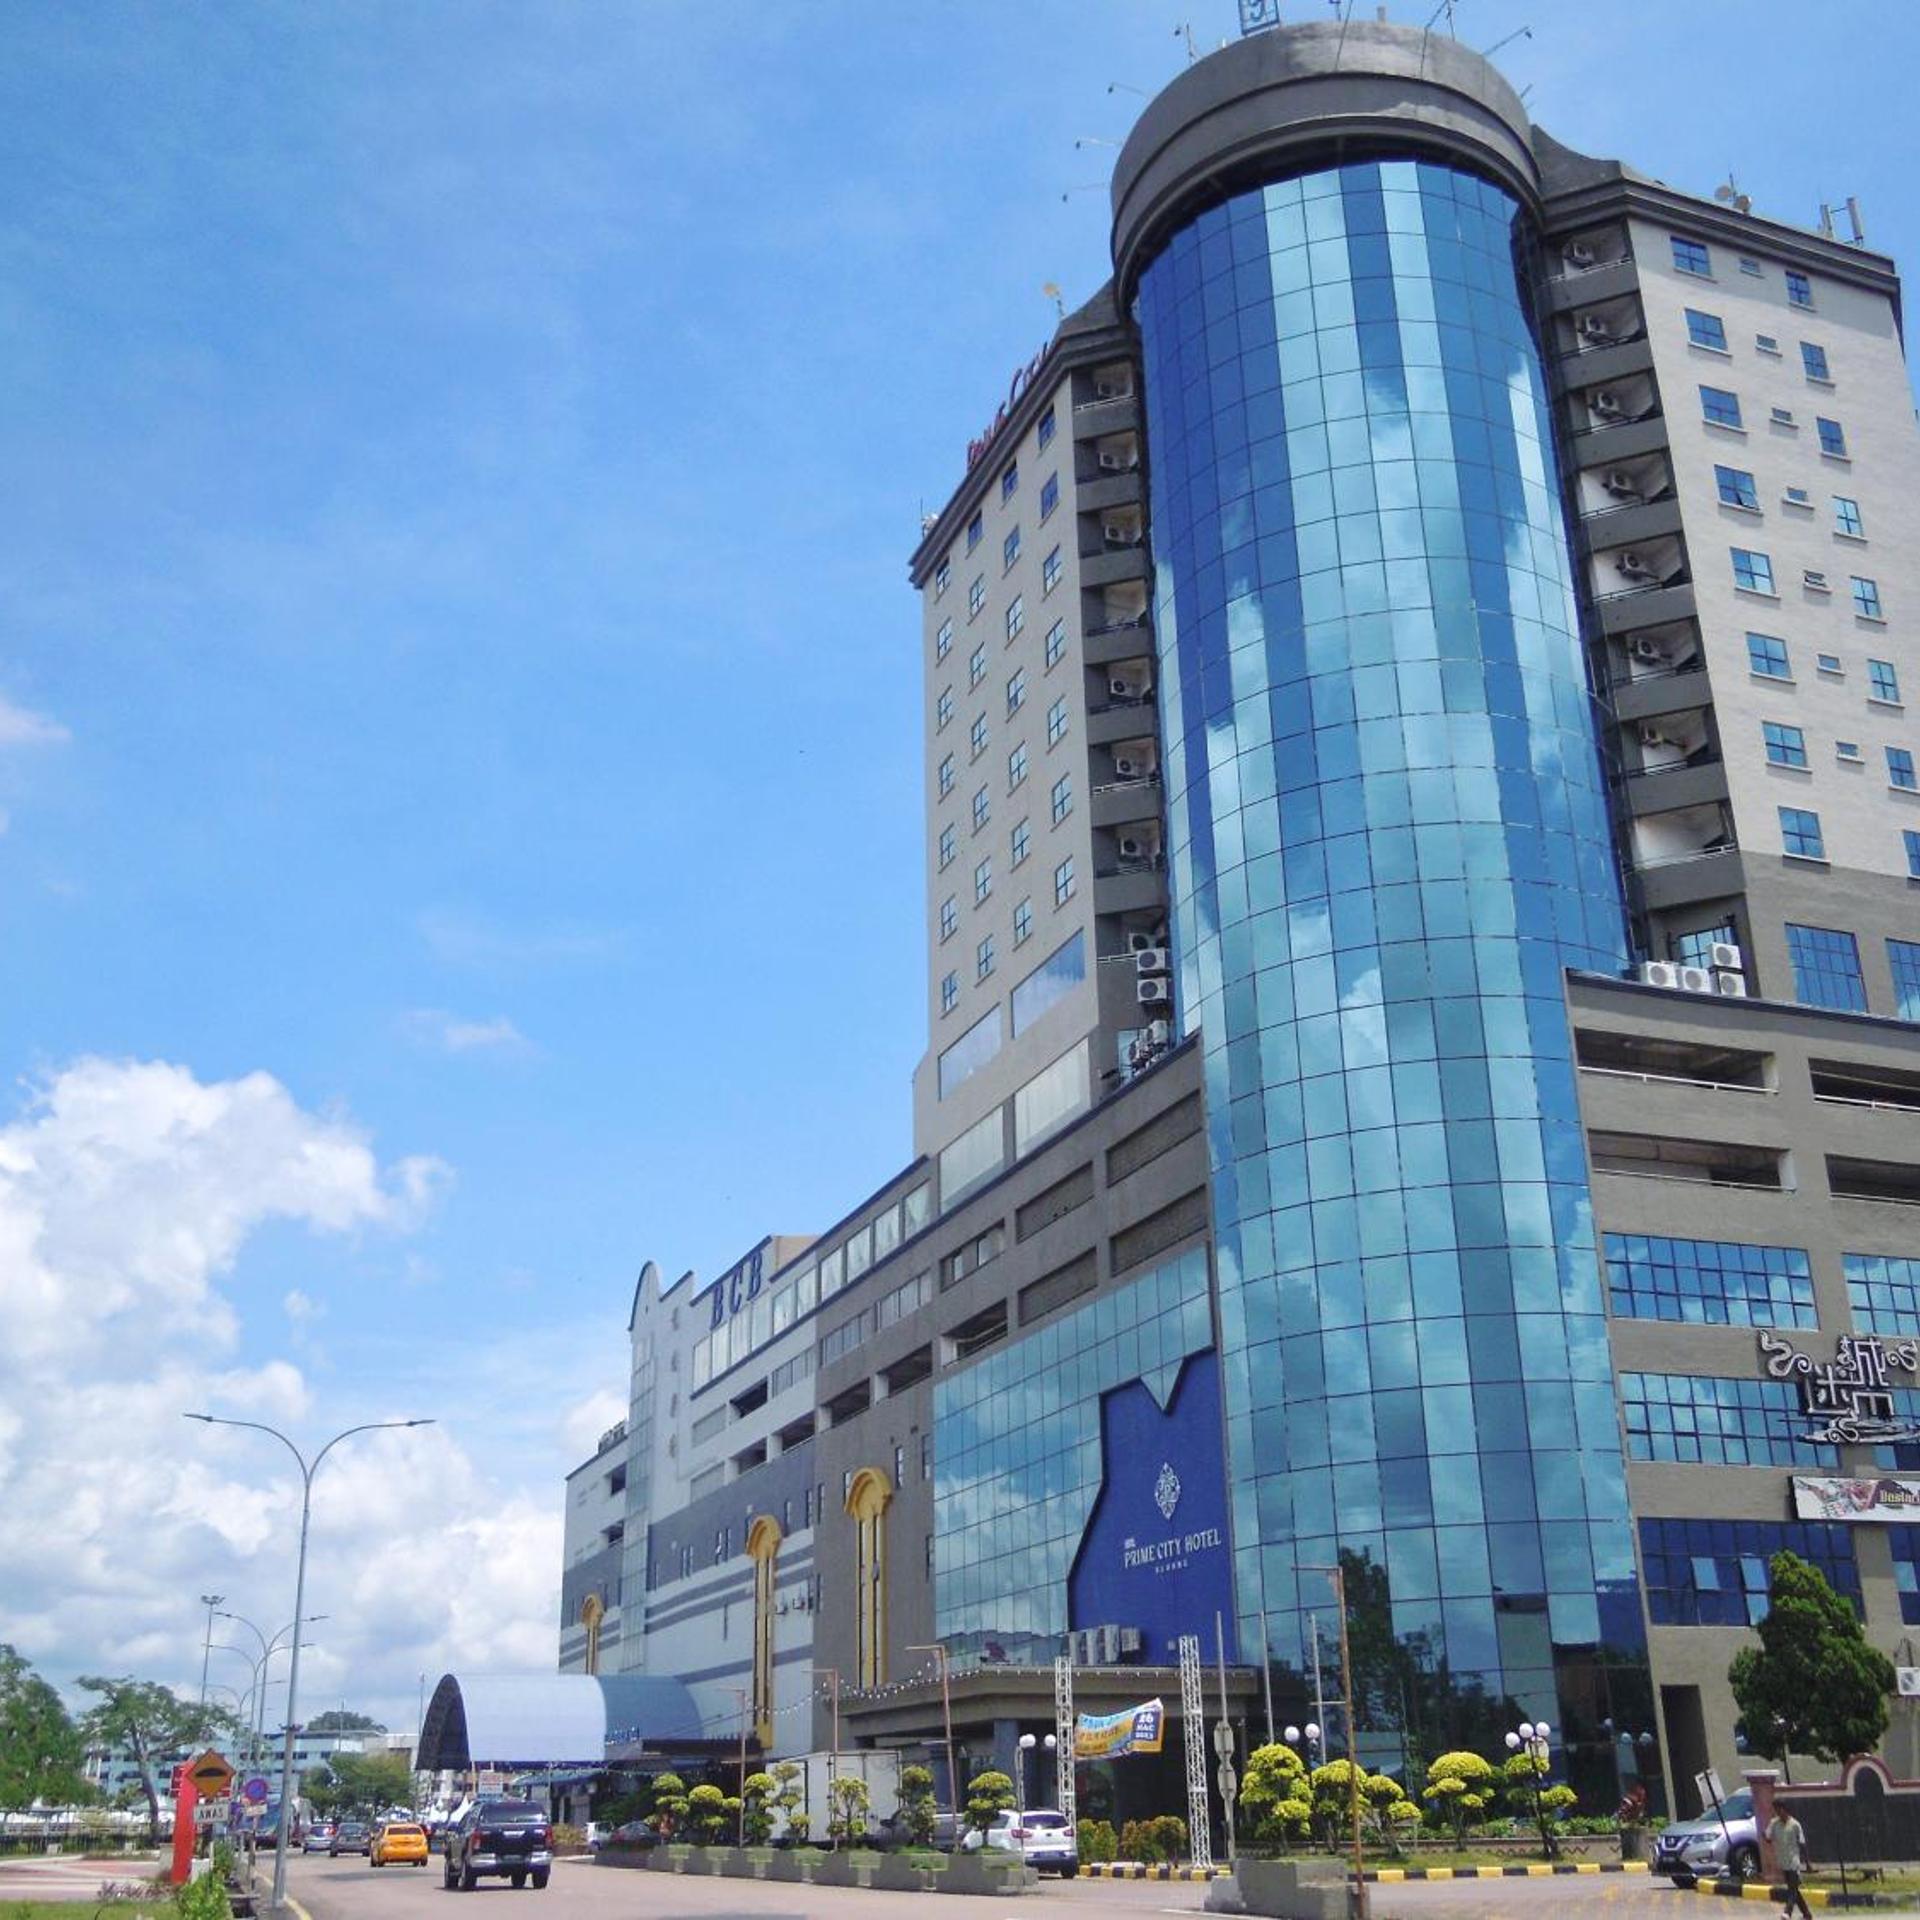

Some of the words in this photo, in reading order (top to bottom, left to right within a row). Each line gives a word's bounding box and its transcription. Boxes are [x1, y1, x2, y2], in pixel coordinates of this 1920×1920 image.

[1124, 1544, 1156, 1569] PRIME
[1156, 1538, 1181, 1560] CITY
[1184, 1528, 1222, 1554] HOTEL
